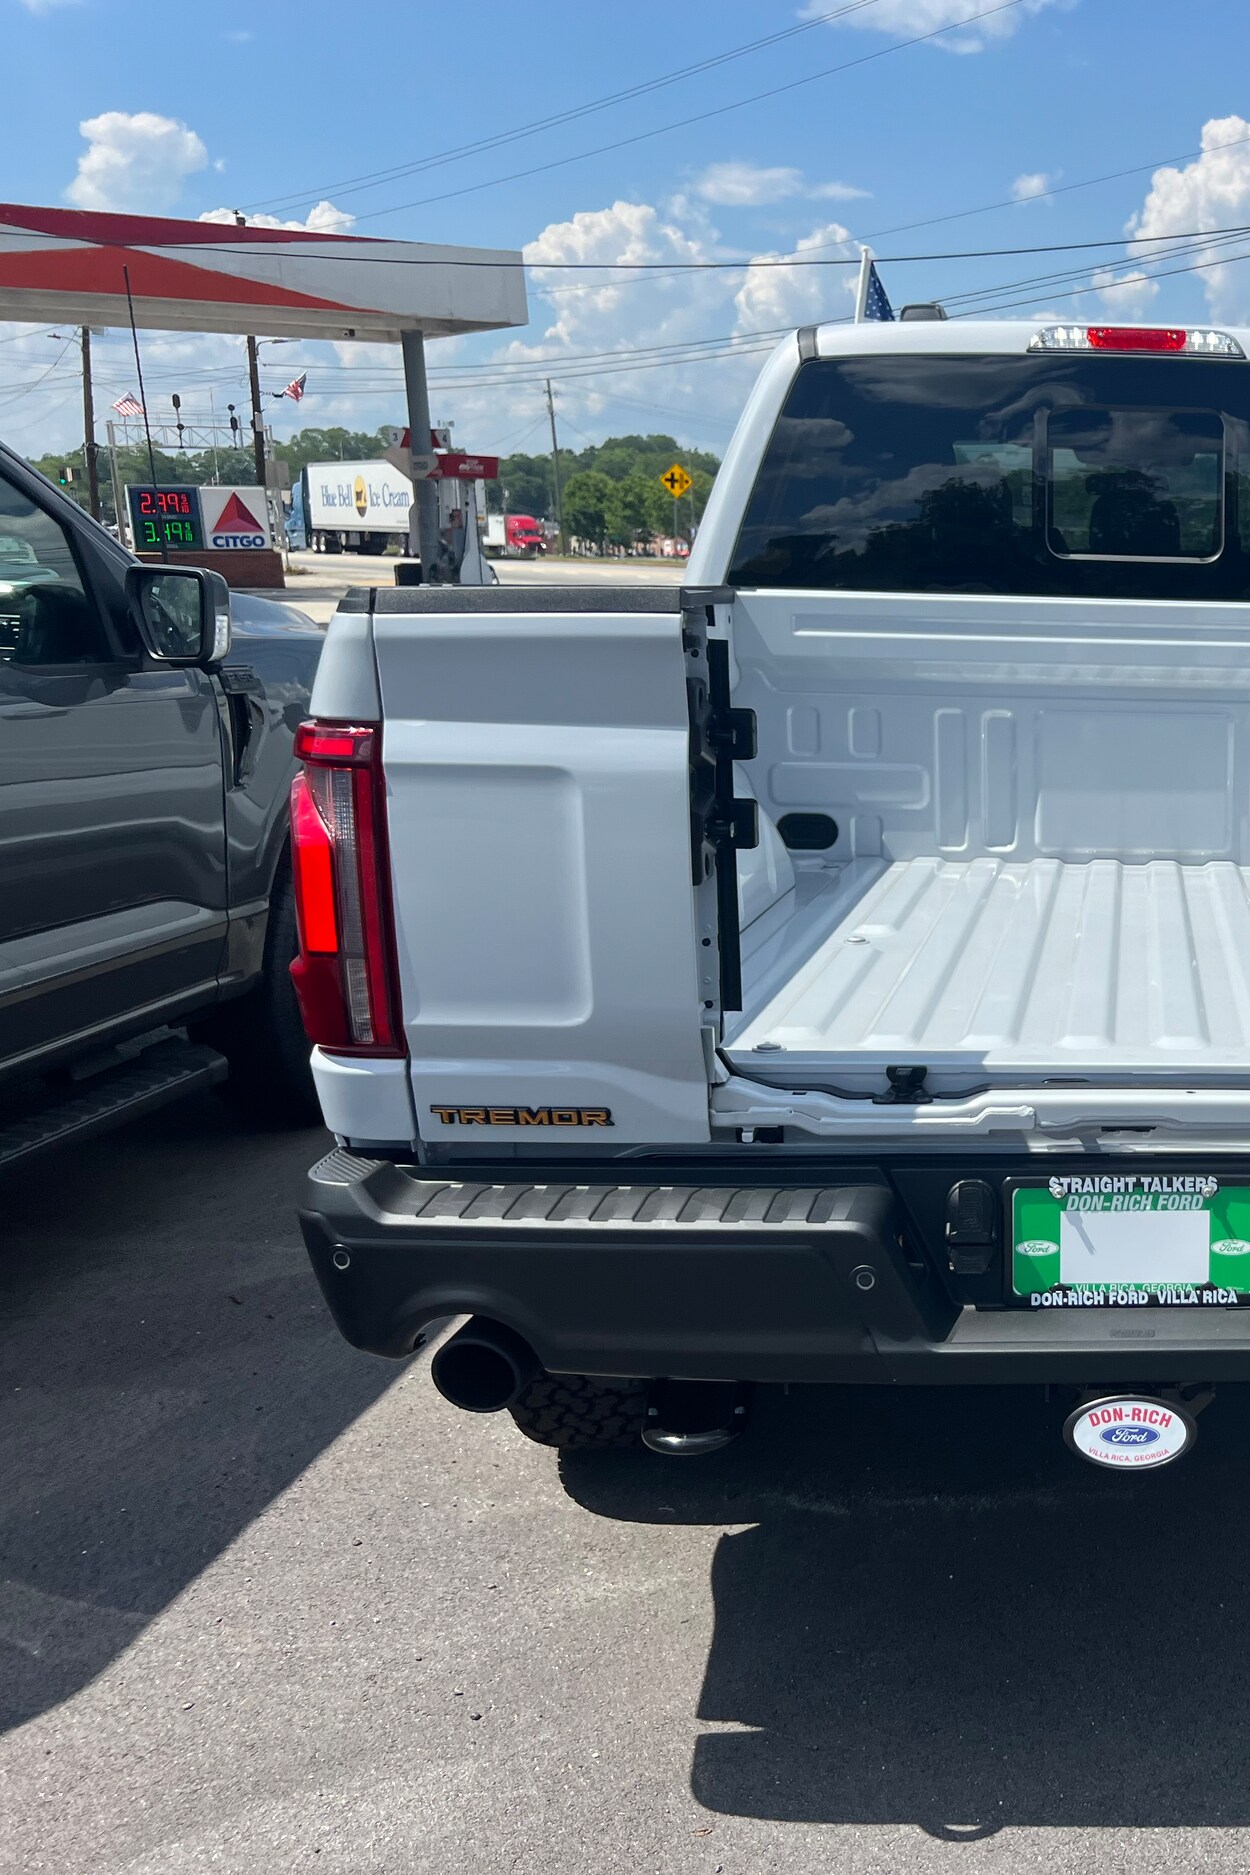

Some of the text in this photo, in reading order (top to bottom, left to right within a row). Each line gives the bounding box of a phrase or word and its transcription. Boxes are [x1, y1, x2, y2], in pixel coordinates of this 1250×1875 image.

[320, 483, 410, 508] Blue Bell Ice Cream
[212, 535, 266, 548] CITGO
[429, 1104, 616, 1127] TREMOR
[1048, 1176, 1218, 1193] STRAIGHT TALKERS
[1066, 1194, 1204, 1212] DON-RICH FORD
[1023, 1242, 1051, 1254] Ford
[1218, 1241, 1245, 1253] Ford
[1030, 1290, 1238, 1306] DON-RICH FORD VILLA RICA
[1088, 1407, 1173, 1428] DON-RICH
[1111, 1427, 1148, 1443] Ford
[1088, 1447, 1110, 1460] VILLA
[1134, 1448, 1170, 1462] GEORGIA
